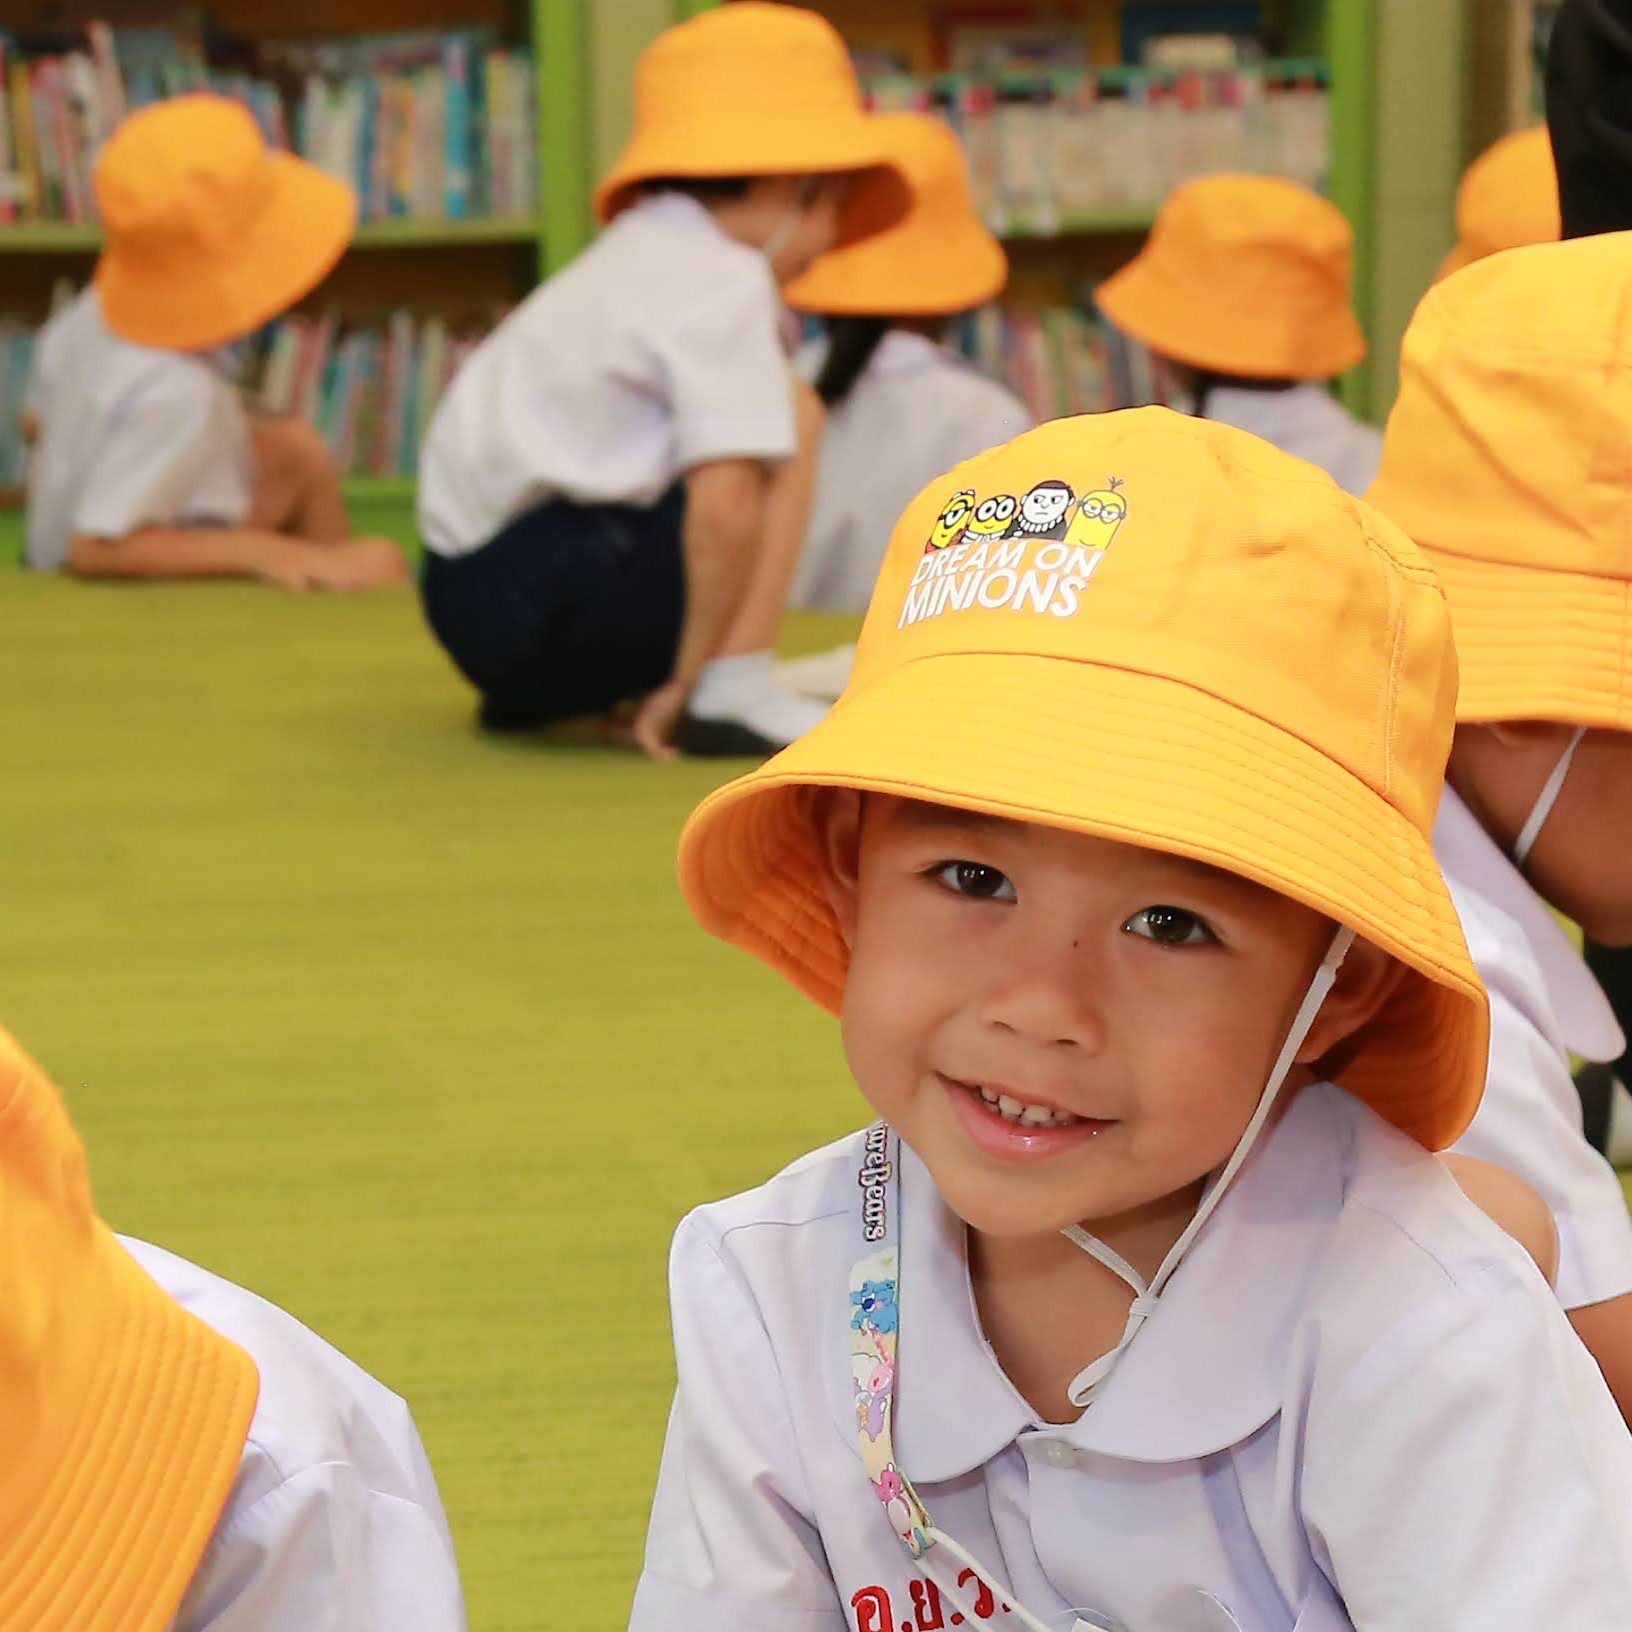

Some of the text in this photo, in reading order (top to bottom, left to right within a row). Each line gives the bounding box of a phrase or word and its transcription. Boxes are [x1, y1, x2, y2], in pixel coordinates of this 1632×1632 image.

[910, 540, 1105, 587] DREAM ON
[897, 568, 1087, 631] MINIONS
[858, 1122, 892, 1242] areBears
